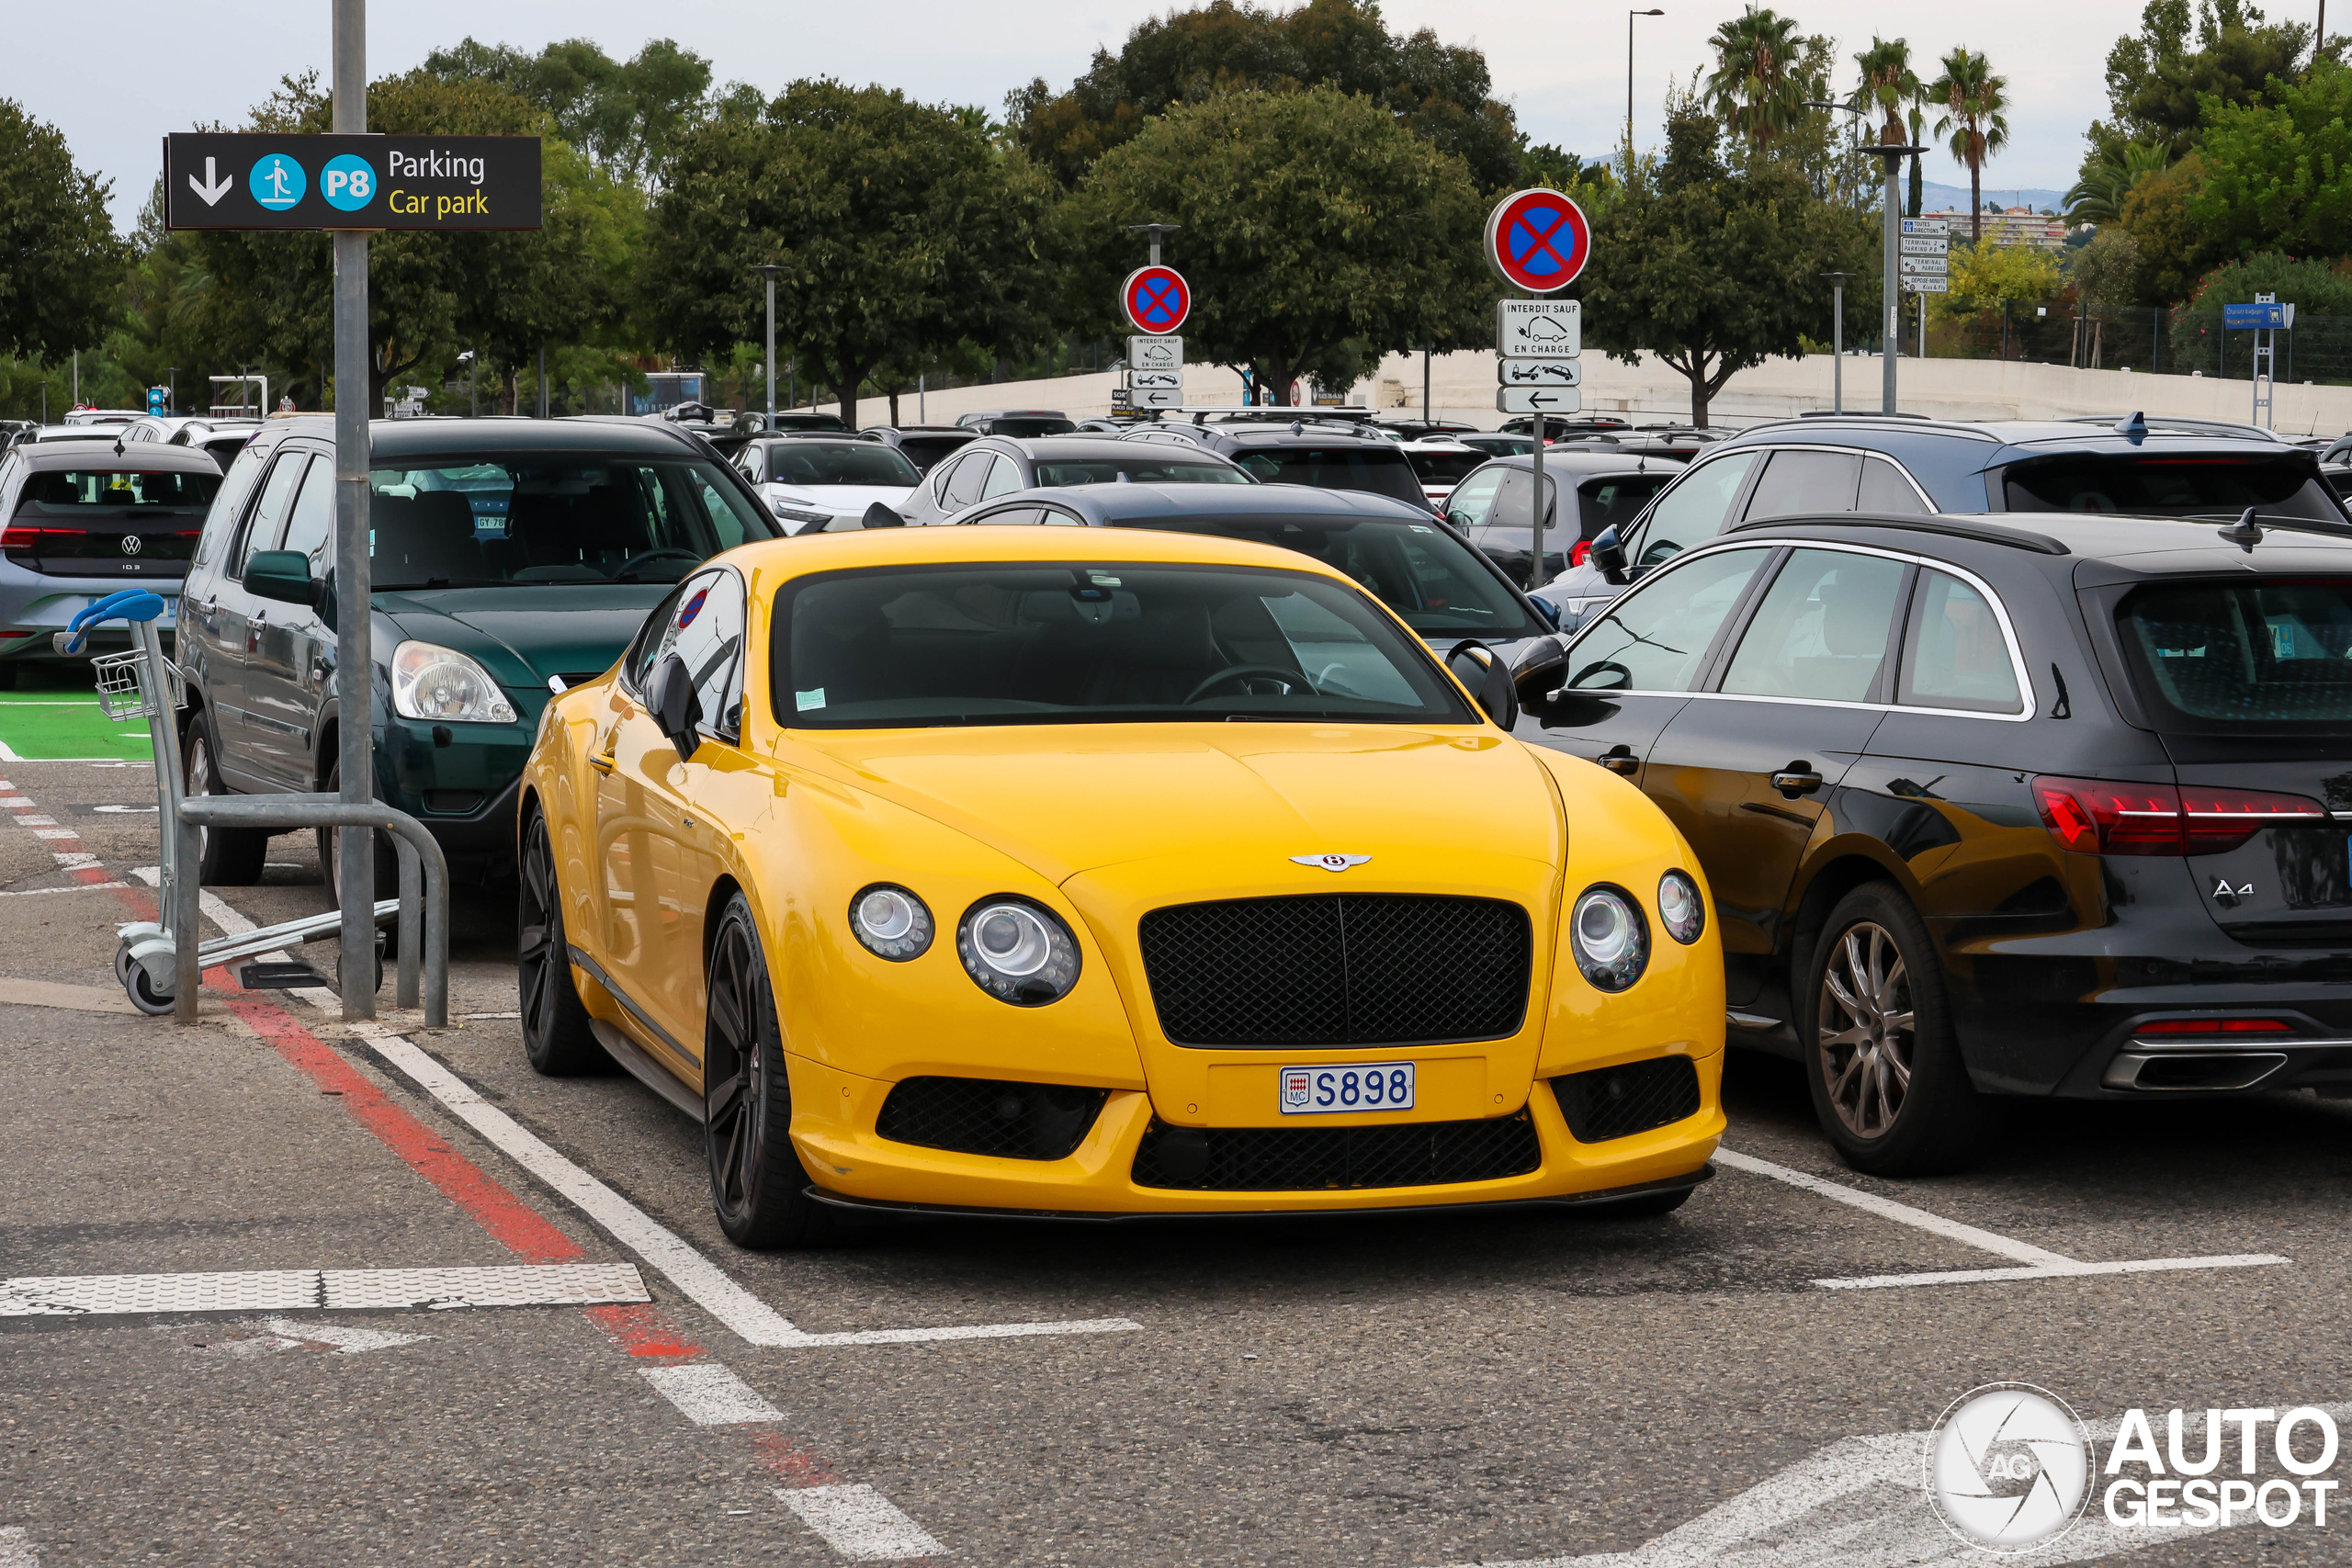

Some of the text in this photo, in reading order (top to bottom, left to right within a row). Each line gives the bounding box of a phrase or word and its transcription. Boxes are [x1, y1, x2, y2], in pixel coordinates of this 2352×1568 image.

[389, 150, 485, 185] Parking
[327, 170, 370, 197] P8
[389, 189, 489, 220] Car park
[1507, 304, 1577, 313] INTERDIT SAUF
[1514, 344, 1527, 353] EN
[2281, 642, 2292, 654] 06
[2212, 879, 2255, 898] A4
[1290, 1091, 1306, 1101] MC
[1316, 1069, 1408, 1106] S898
